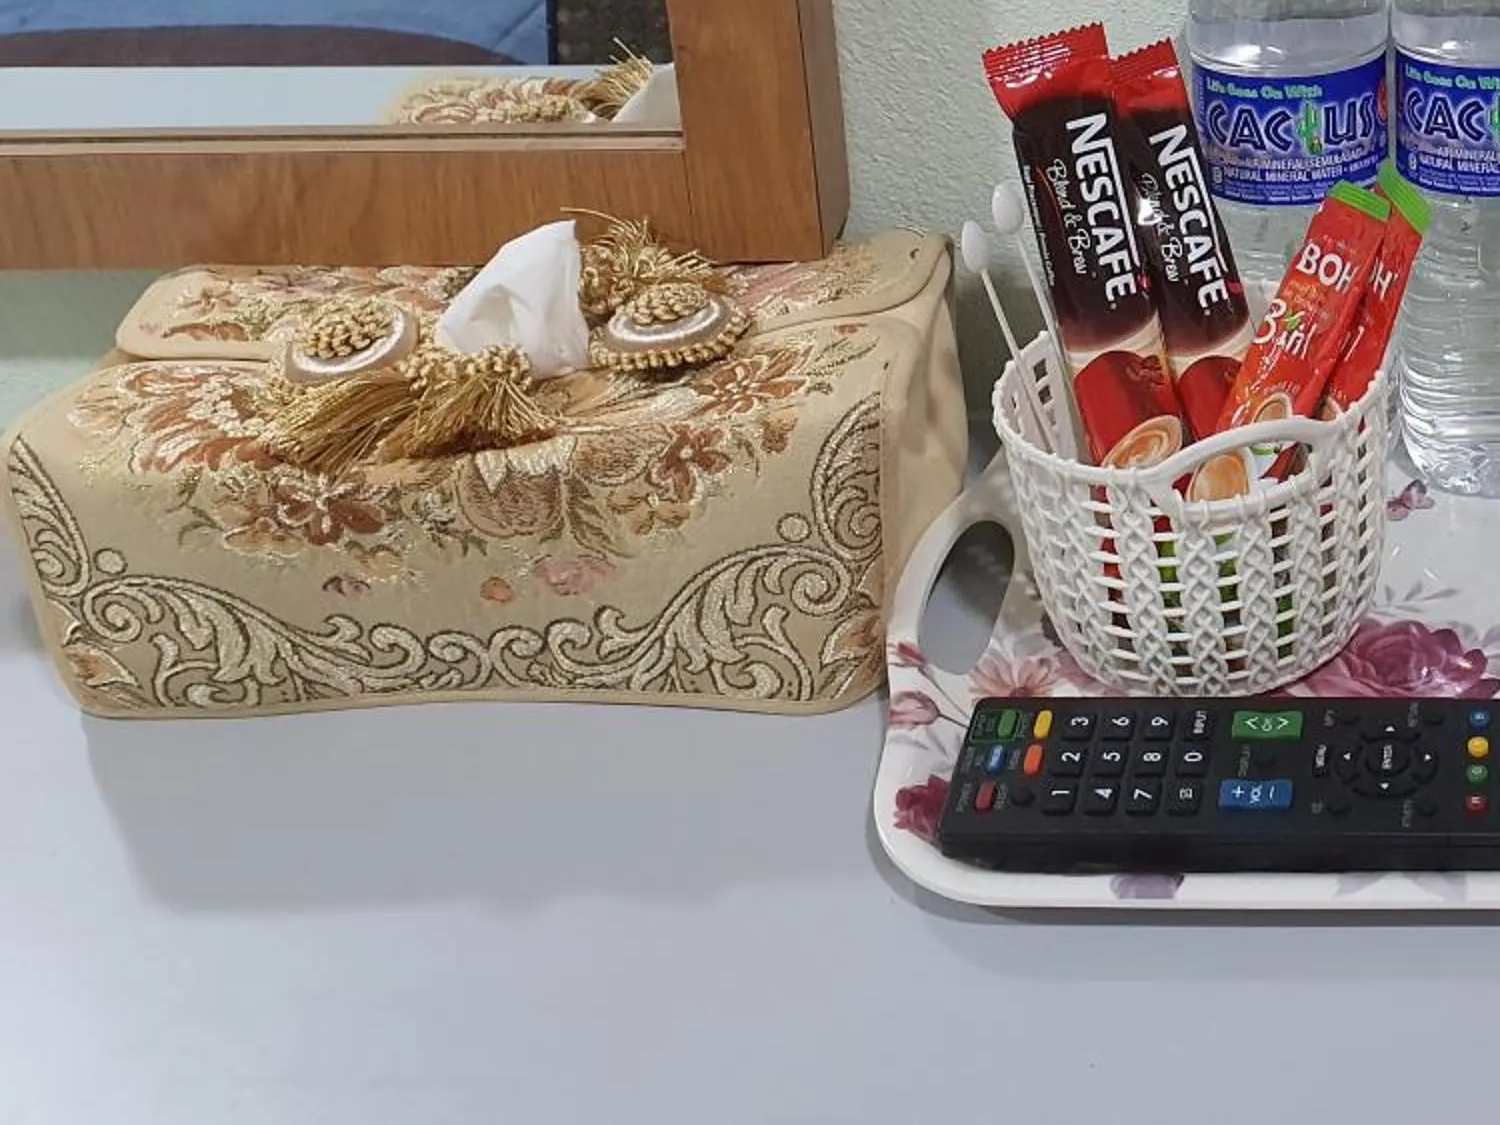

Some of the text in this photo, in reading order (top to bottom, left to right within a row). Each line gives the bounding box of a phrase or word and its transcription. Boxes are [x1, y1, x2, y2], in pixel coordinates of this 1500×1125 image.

[1455, 75, 1477, 89] On
[1260, 86, 1285, 100] On
[1456, 159, 1500, 174] MINERAL
[1265, 168, 1309, 182] MINERAL
[1295, 242, 1358, 293] BOH
[1071, 716, 1089, 726] 3
[1111, 716, 1130, 726] 6
[1151, 716, 1169, 726] 9
[1061, 752, 1081, 762] 2
[1103, 752, 1121, 762] 5
[1143, 752, 1162, 762] 8
[1183, 751, 1203, 762] 0
[1095, 788, 1113, 799] 4
[1133, 788, 1152, 800] 7
